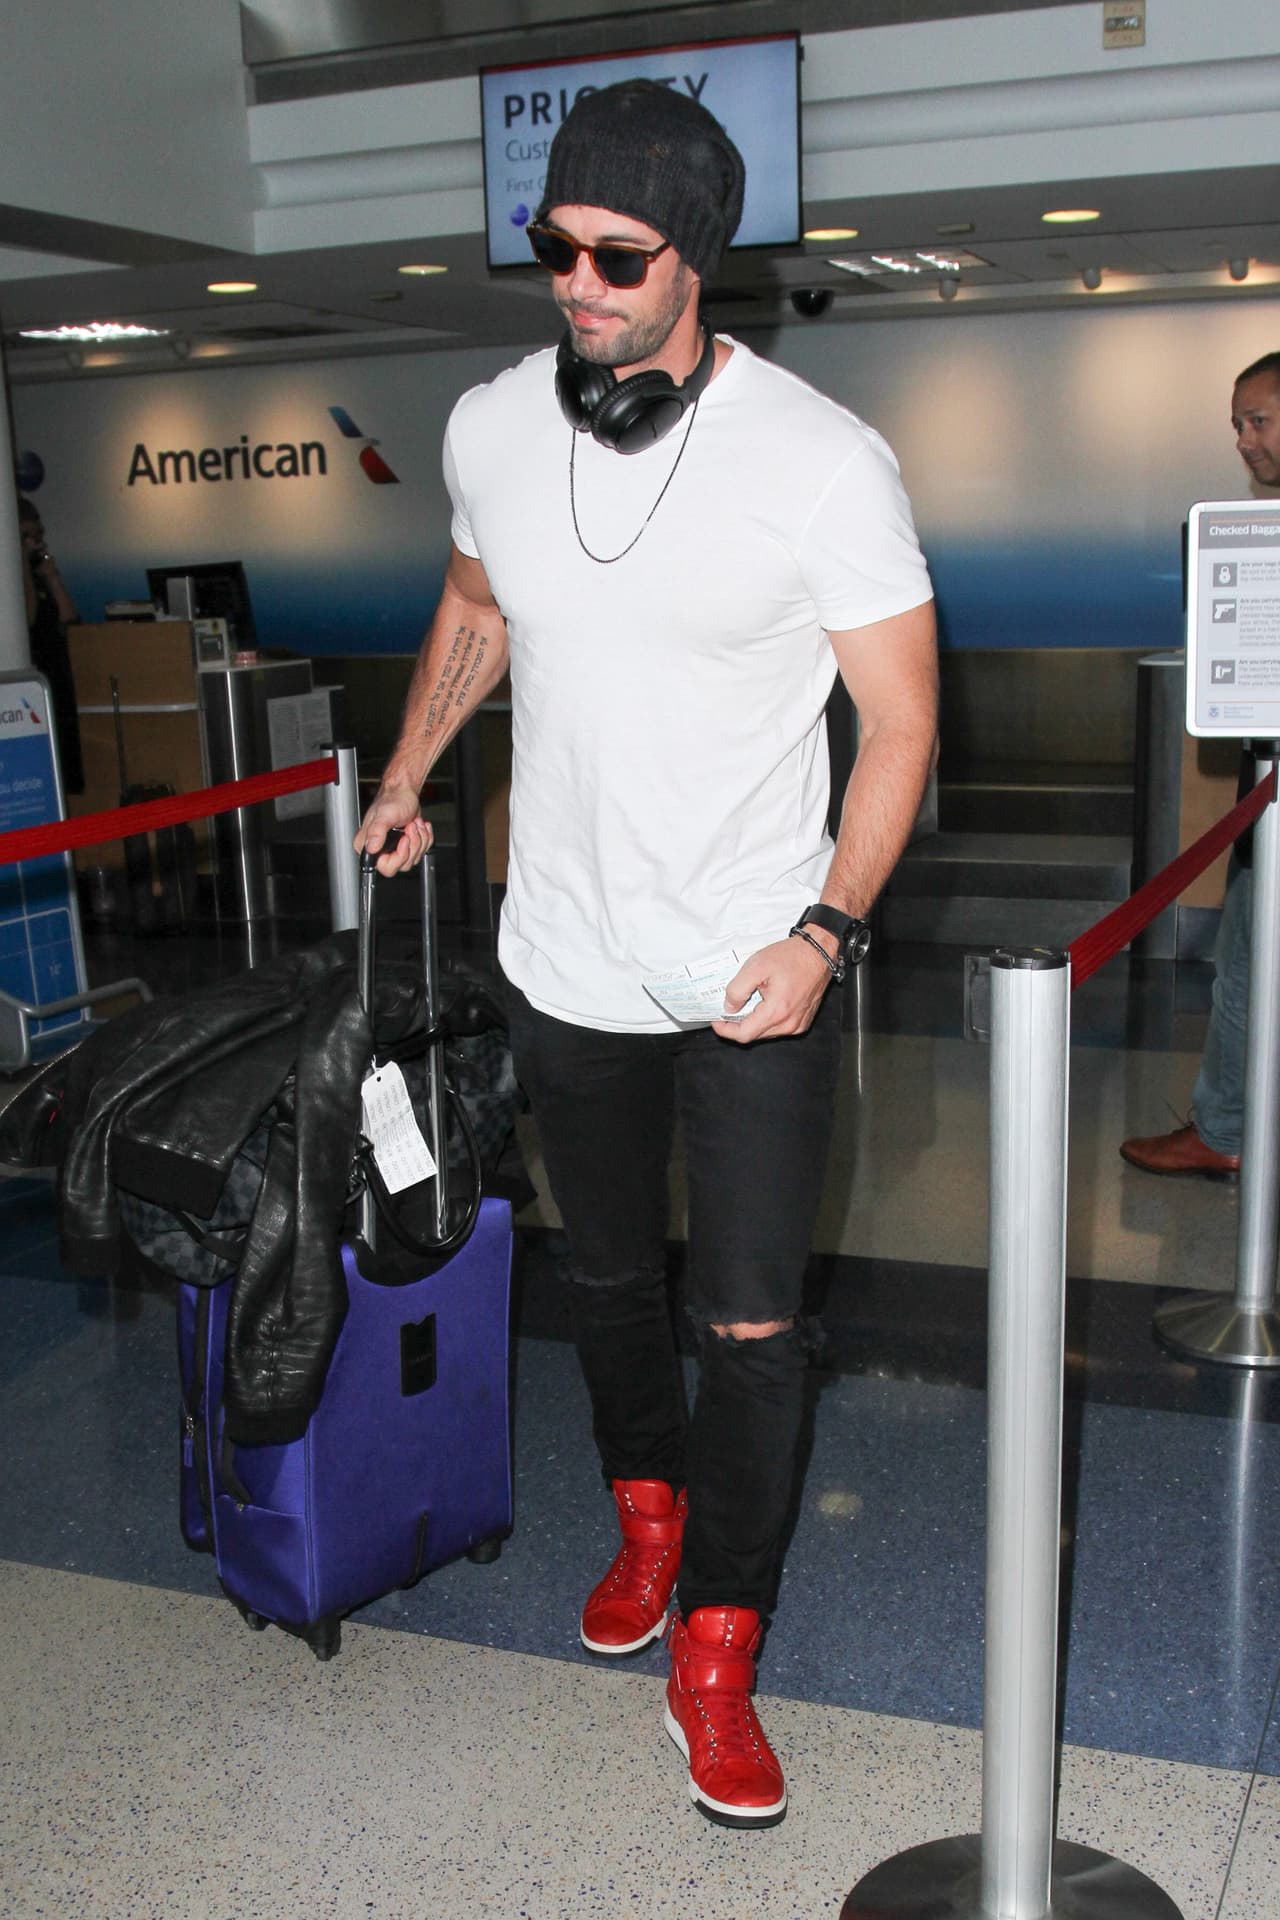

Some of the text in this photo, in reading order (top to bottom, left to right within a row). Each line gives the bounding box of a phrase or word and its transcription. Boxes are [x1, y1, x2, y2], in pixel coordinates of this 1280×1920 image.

[506, 178, 533, 192] First
[128, 435, 327, 485] American
[1209, 524, 1249, 536] Checked
